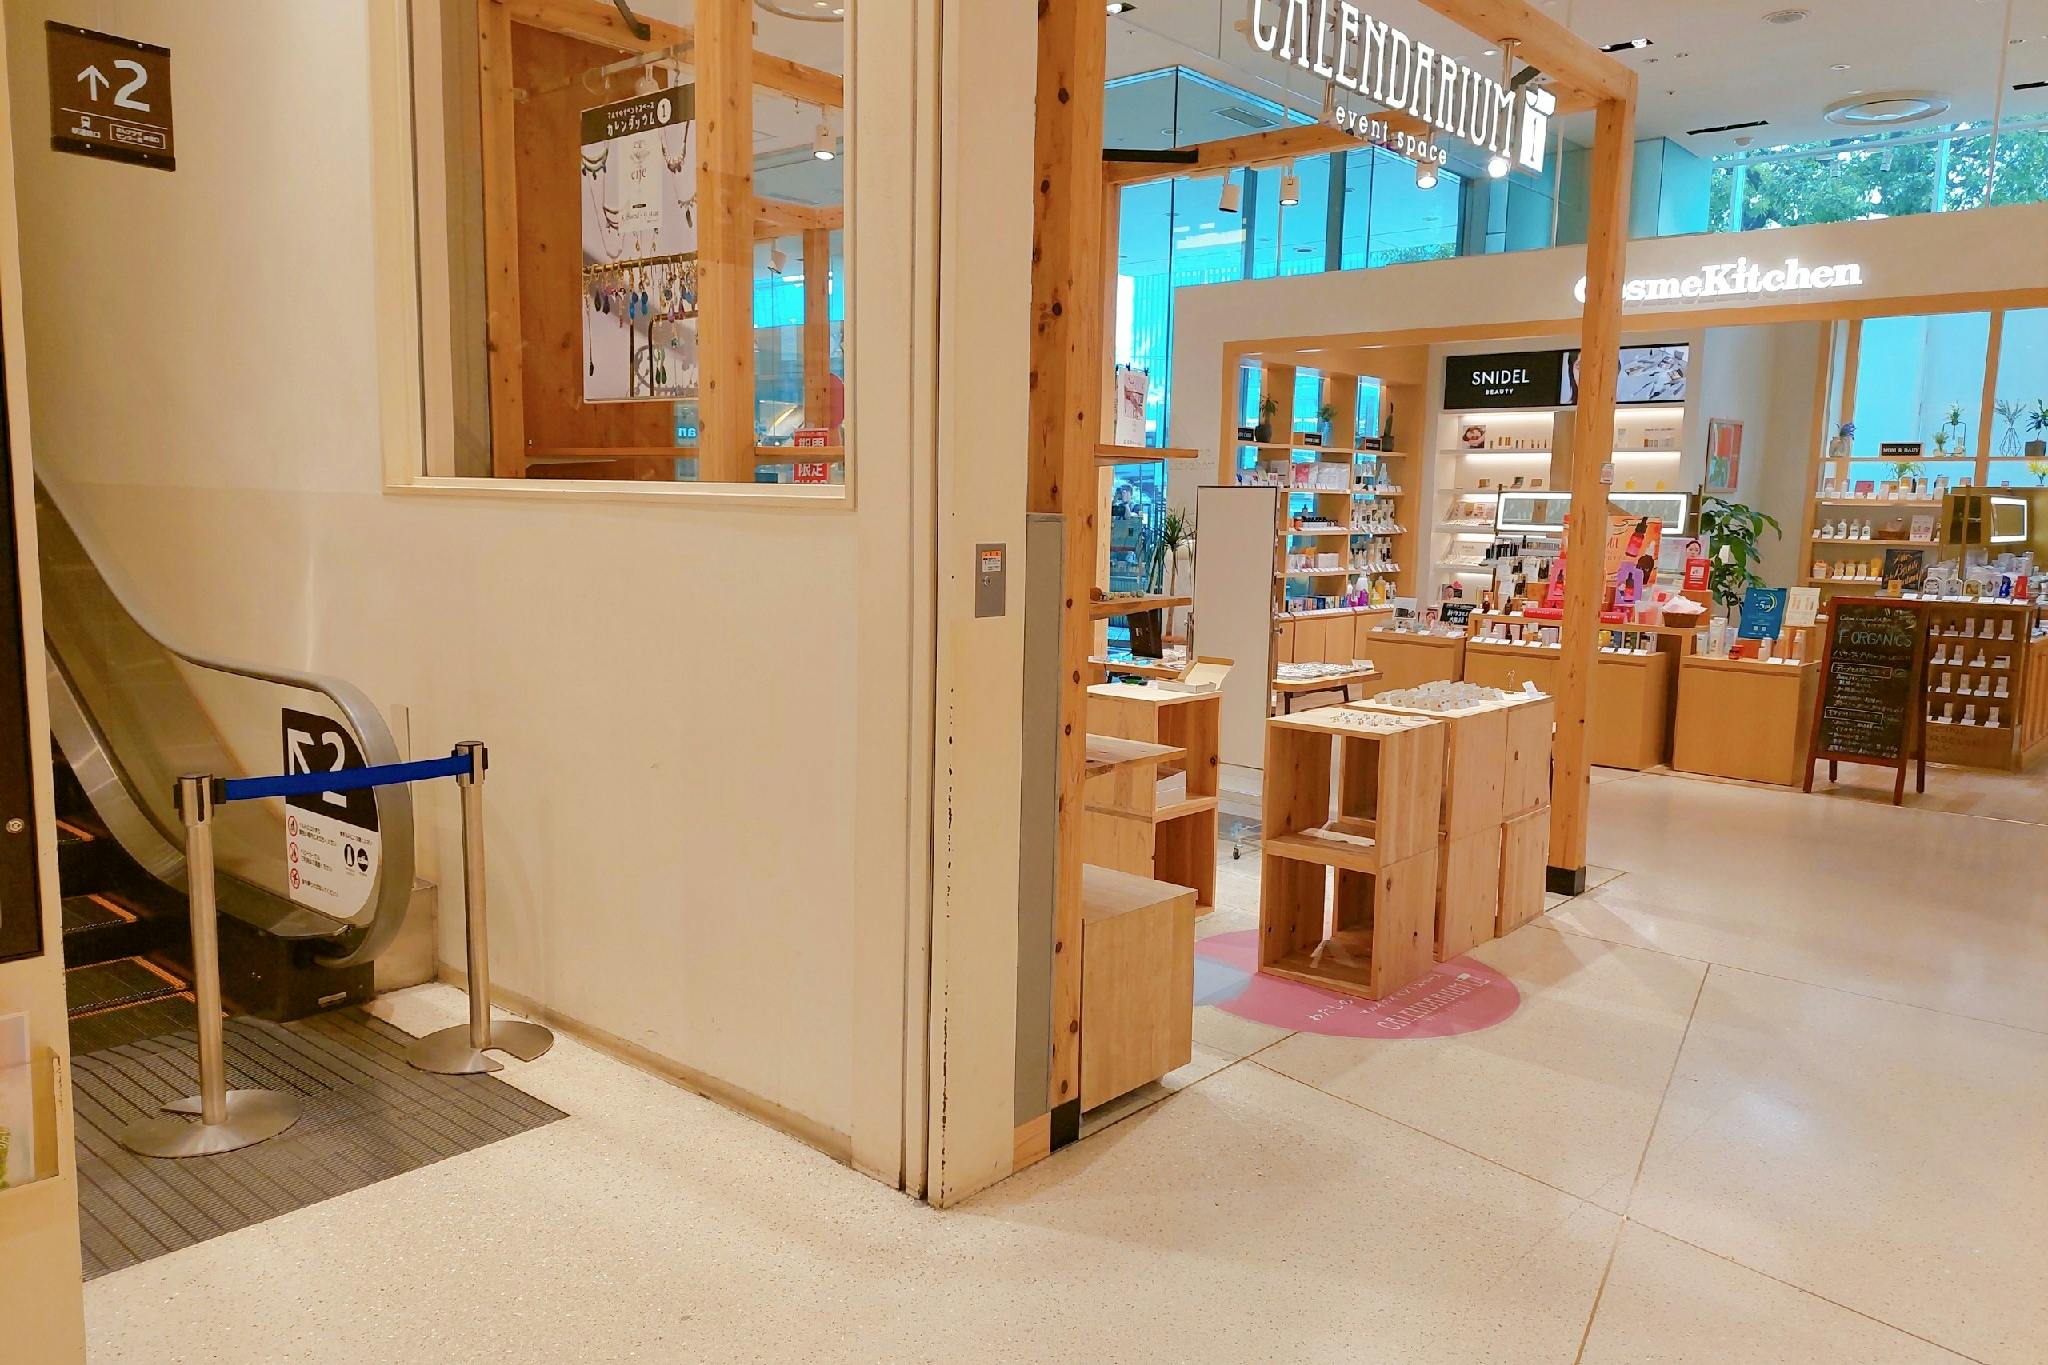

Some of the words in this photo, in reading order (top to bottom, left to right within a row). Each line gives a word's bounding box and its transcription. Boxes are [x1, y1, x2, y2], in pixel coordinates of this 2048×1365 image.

[114, 59, 150, 112] 2
[1253, 0, 1515, 157] CALENDARIUM
[1335, 104, 1389, 142] event
[1397, 130, 1448, 165] space
[1574, 256, 1863, 303] smeKitchen
[1471, 368, 1530, 385] SNIDEL
[1485, 388, 1514, 396] BEAUTY
[798, 463, 824, 477] 限定
[1838, 628, 1851, 644] F
[1851, 630, 1913, 648] ORGANICS
[321, 731, 347, 809] 2
